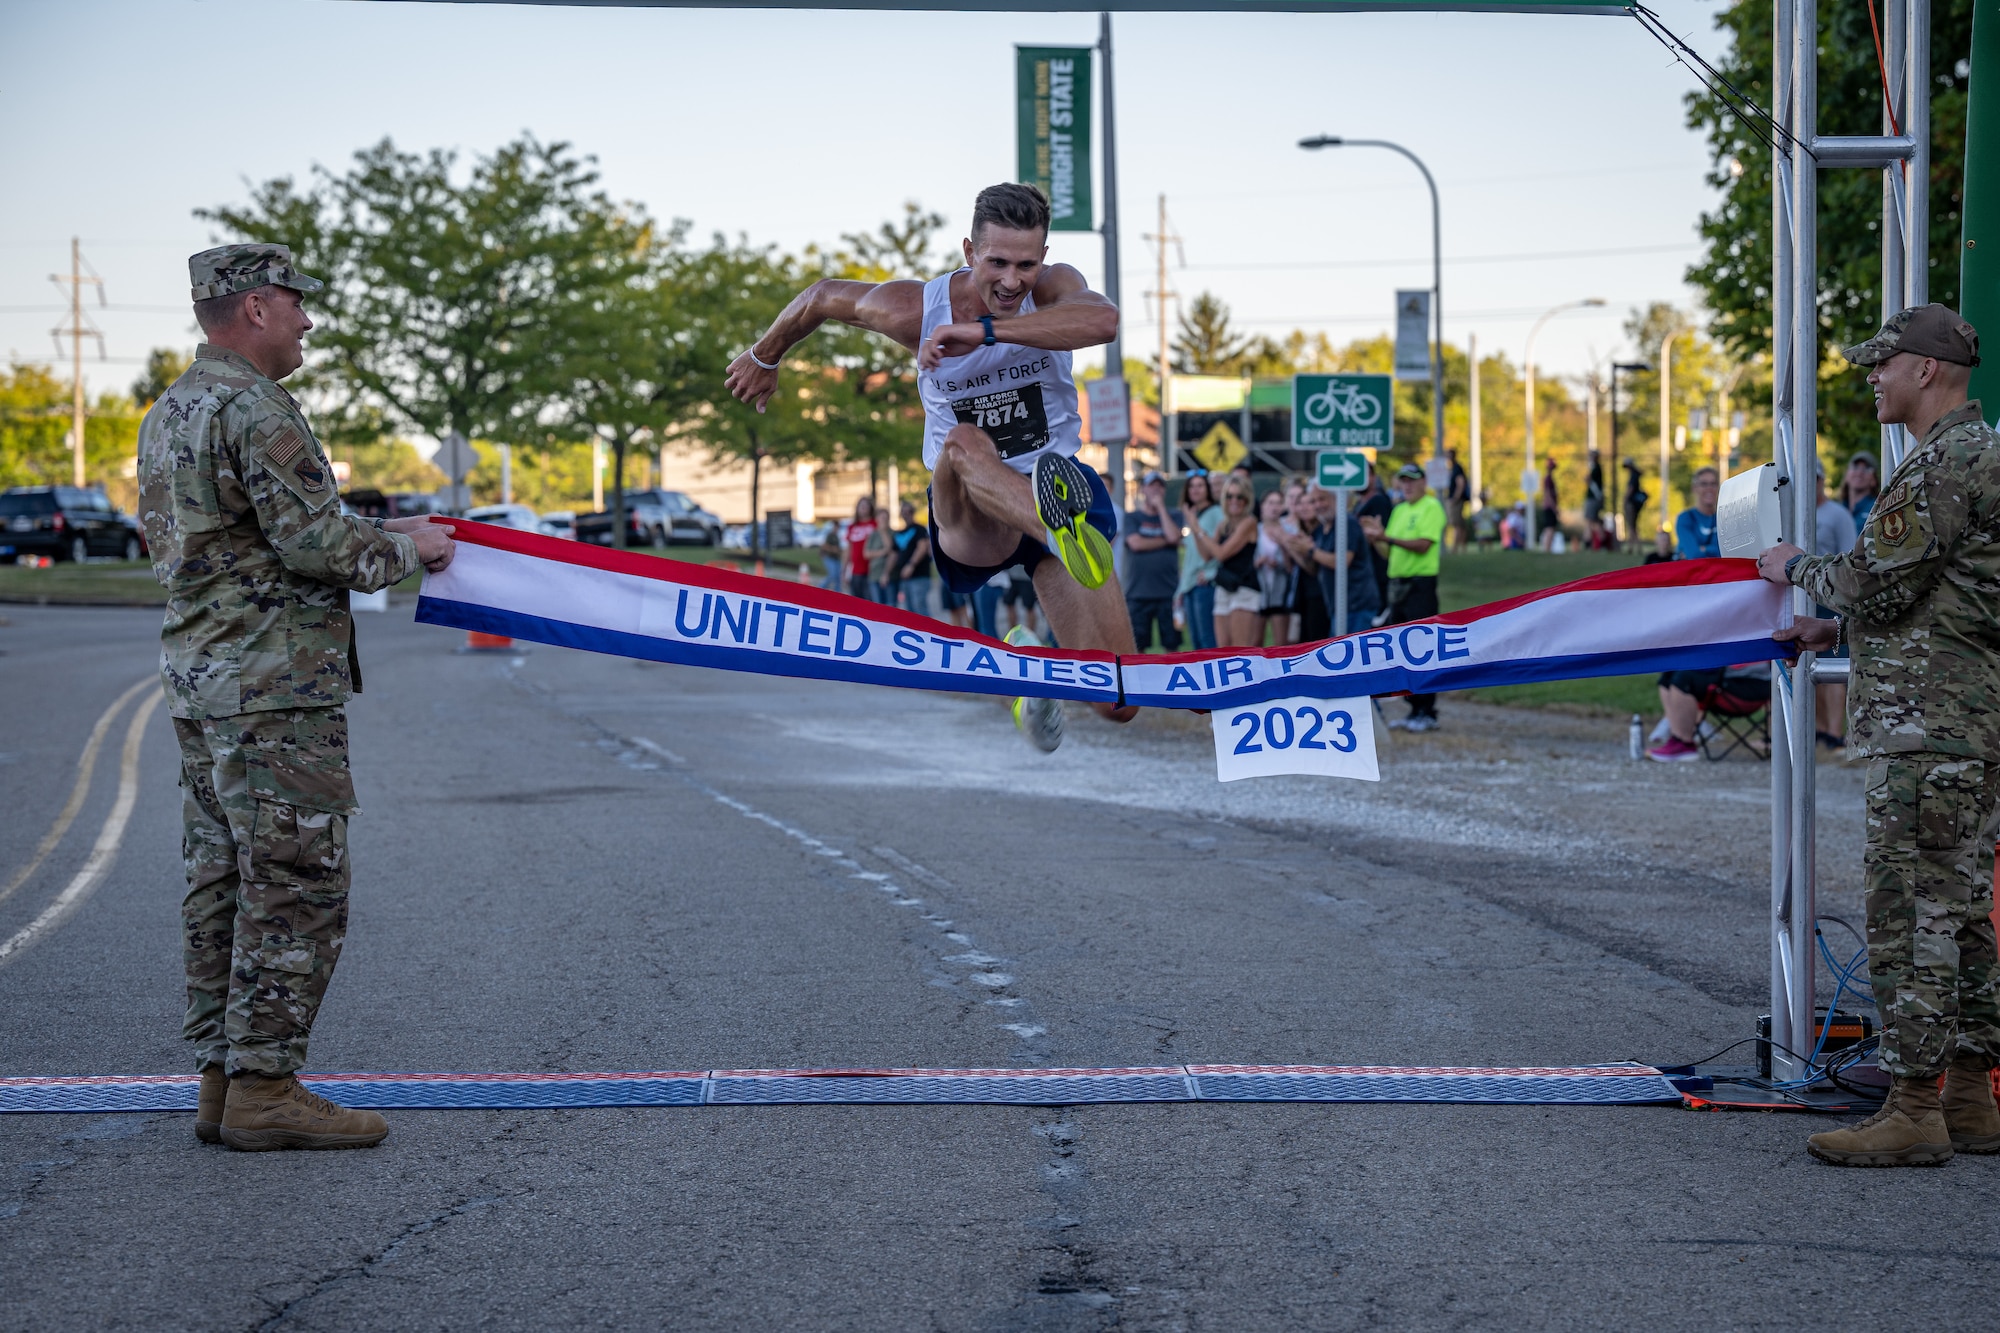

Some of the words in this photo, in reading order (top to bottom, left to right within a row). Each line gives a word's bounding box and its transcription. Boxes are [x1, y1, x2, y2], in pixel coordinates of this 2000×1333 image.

[1049, 58, 1075, 127] STATE
[1049, 131, 1075, 219] WRIGHT
[966, 374, 991, 389] AIR
[997, 356, 1050, 382] FORCE
[971, 401, 1029, 428] 7874
[974, 395, 989, 405] AIR
[990, 390, 1018, 402] FORCE
[975, 396, 1020, 410] MARATHON
[1301, 429, 1335, 446] BIKE
[1340, 429, 1384, 446] ROUTE
[675, 589, 871, 657] UNITED
[891, 630, 1114, 687] STATES
[1166, 657, 1253, 691] AIR
[1282, 625, 1470, 675] FORCE
[1231, 706, 1358, 756] 2023
